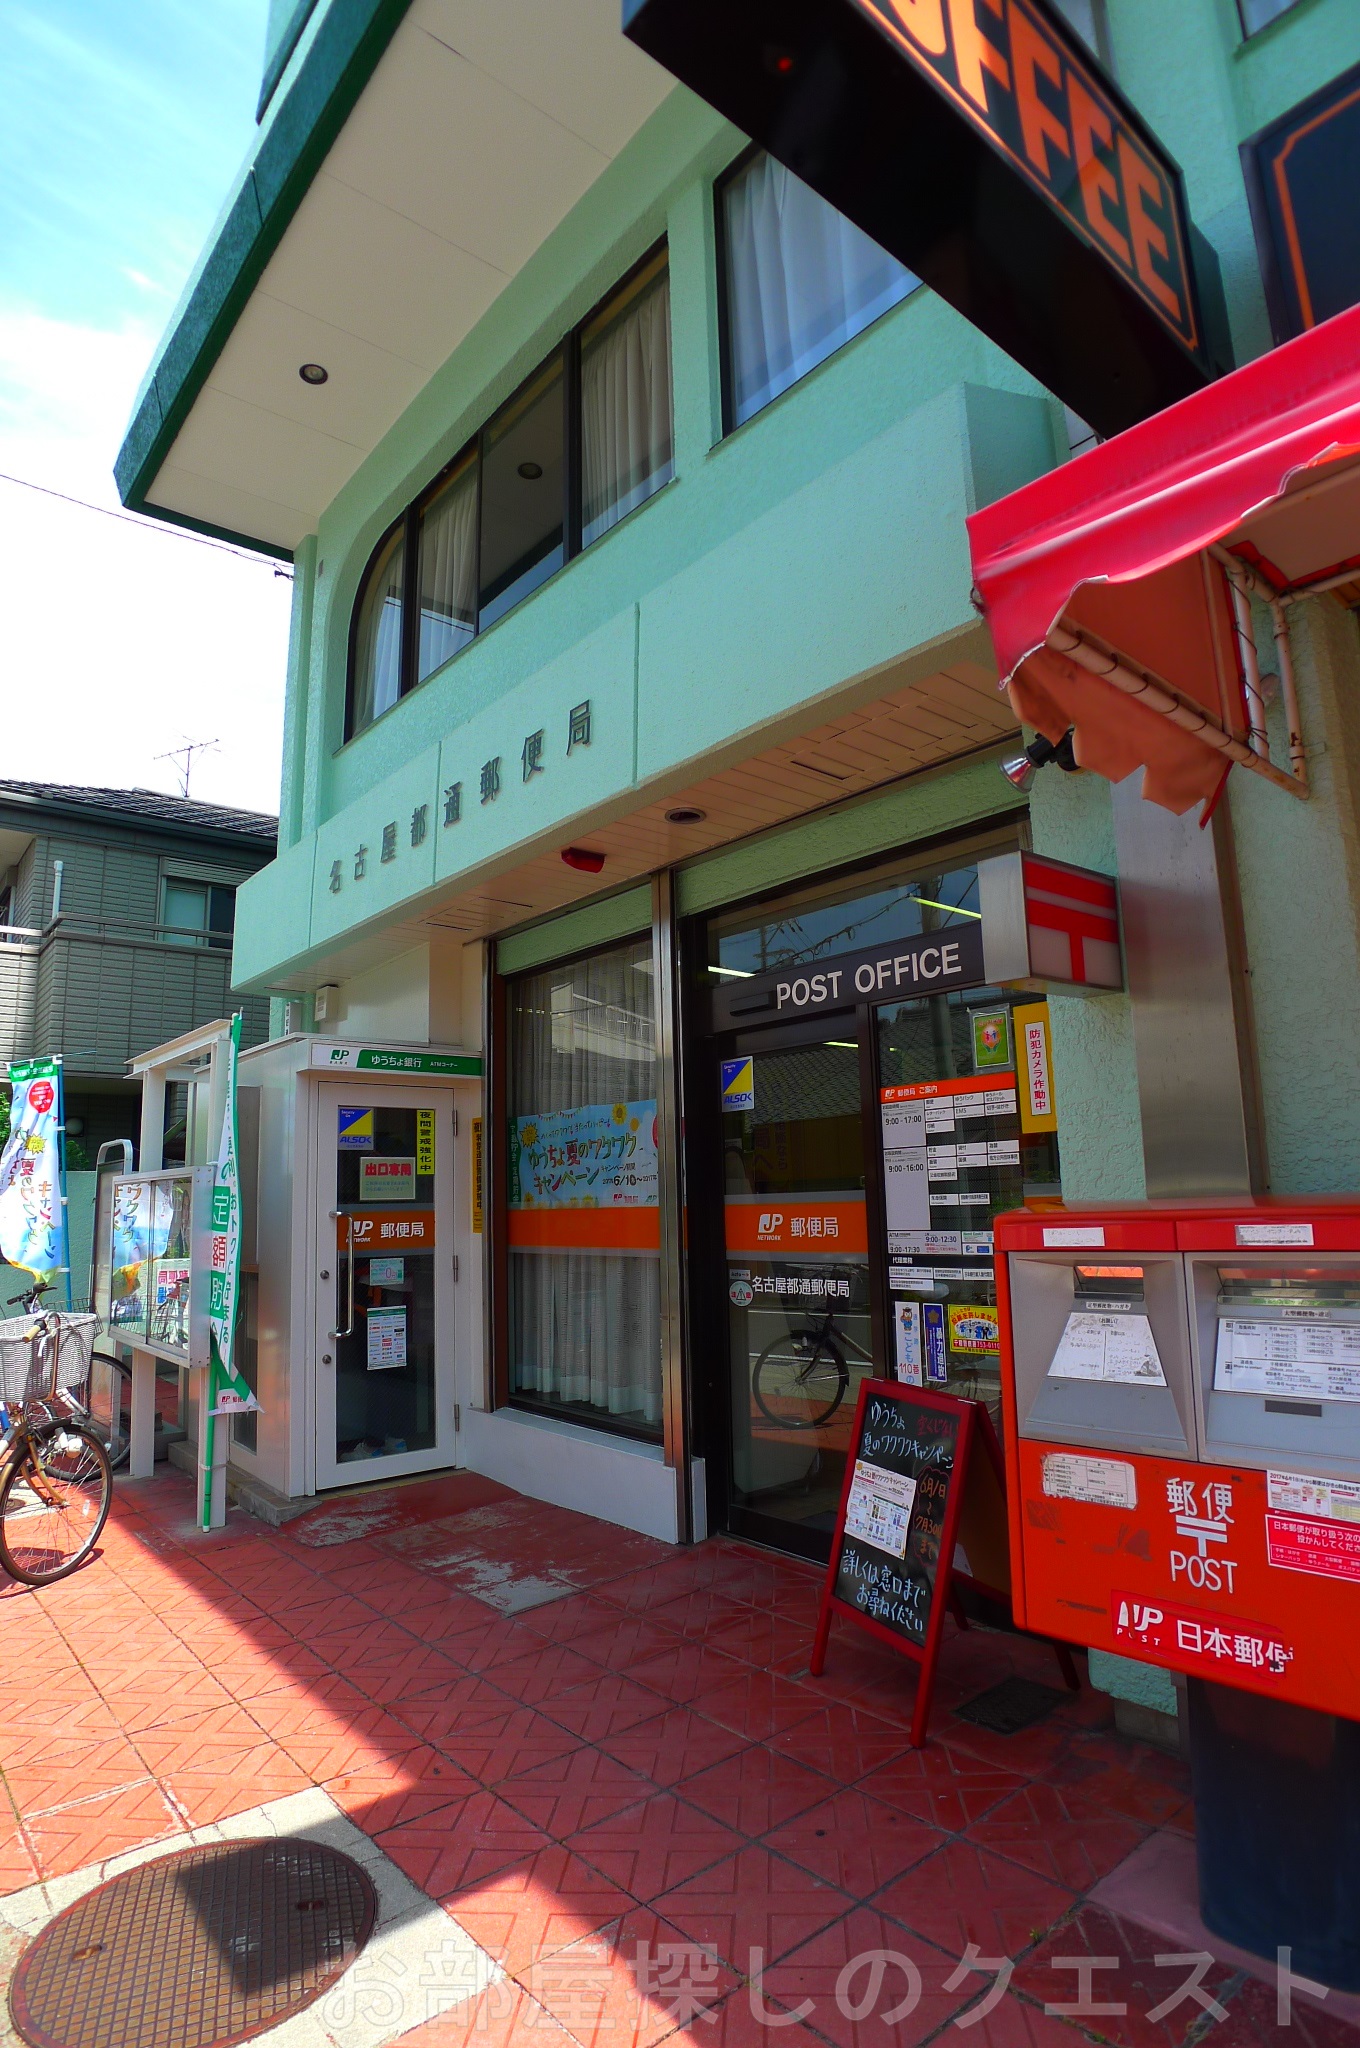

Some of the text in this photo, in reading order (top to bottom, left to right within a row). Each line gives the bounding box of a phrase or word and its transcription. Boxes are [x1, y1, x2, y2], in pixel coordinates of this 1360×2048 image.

[328, 699, 592, 894] 名古屋都通郵便局
[776, 943, 962, 1010] POST OFFICE
[330, 1049, 350, 1061] JP
[371, 1055, 422, 1068] ゆうちょ銀行
[1029, 1029, 1046, 1111] 防犯カメラ作動中
[723, 1092, 752, 1104] ALSOK
[897, 1088, 916, 1097] 郵便局
[919, 1085, 938, 1094] ご案内
[339, 1136, 372, 1144] ALSOK
[419, 1111, 432, 1172] 夜間警戒強化中
[528, 1133, 637, 1170] ゆうちょ夏のワクワク
[365, 1163, 412, 1176] 出口専用
[533, 1166, 600, 1195] キャンペーン
[380, 1222, 424, 1238] 郵便局
[758, 1213, 784, 1234] JP
[791, 1217, 839, 1238] 郵便局
[752, 1275, 850, 1298] 名古屋都通郵便局
[871, 1401, 906, 1431] ゆうちょ
[863, 1431, 954, 1469] 夏のワクワクキャンペーン
[1166, 1478, 1234, 1524] 郵便
[842, 1549, 926, 1608] 詳しくは窓口まで
[1170, 1551, 1238, 1593] POST
[856, 1583, 924, 1632] お尋ねください
[1117, 1627, 1161, 1646] PST
